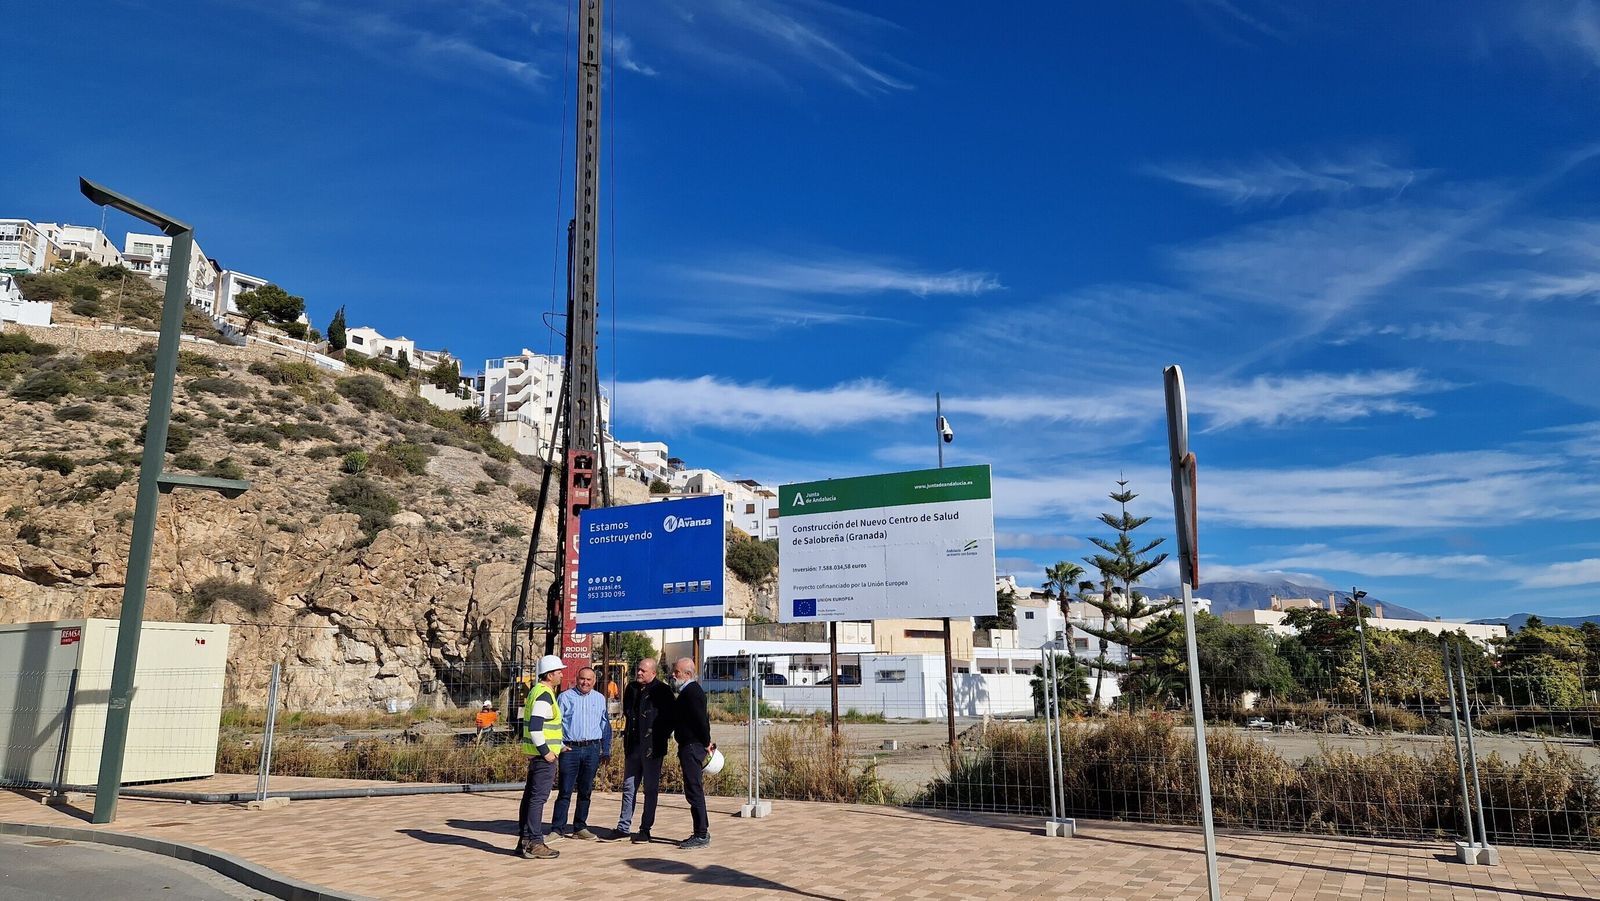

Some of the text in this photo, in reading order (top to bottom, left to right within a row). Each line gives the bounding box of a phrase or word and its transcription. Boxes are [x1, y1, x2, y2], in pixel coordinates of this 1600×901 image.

[914, 480, 973, 490] www.juntadeandalucia.es
[812, 495, 837, 503] Andalucía
[590, 521, 629, 532] Estamos
[677, 518, 711, 528] Avanza
[792, 511, 959, 533] Construcción del Nuevo Centro de Salud
[589, 531, 652, 544] construyendo
[792, 530, 888, 546] de Salobreña (Granada)
[588, 584, 621, 592] avanzasi.es
[793, 584, 815, 592] Proyecto
[587, 590, 626, 599] 953 330 095
